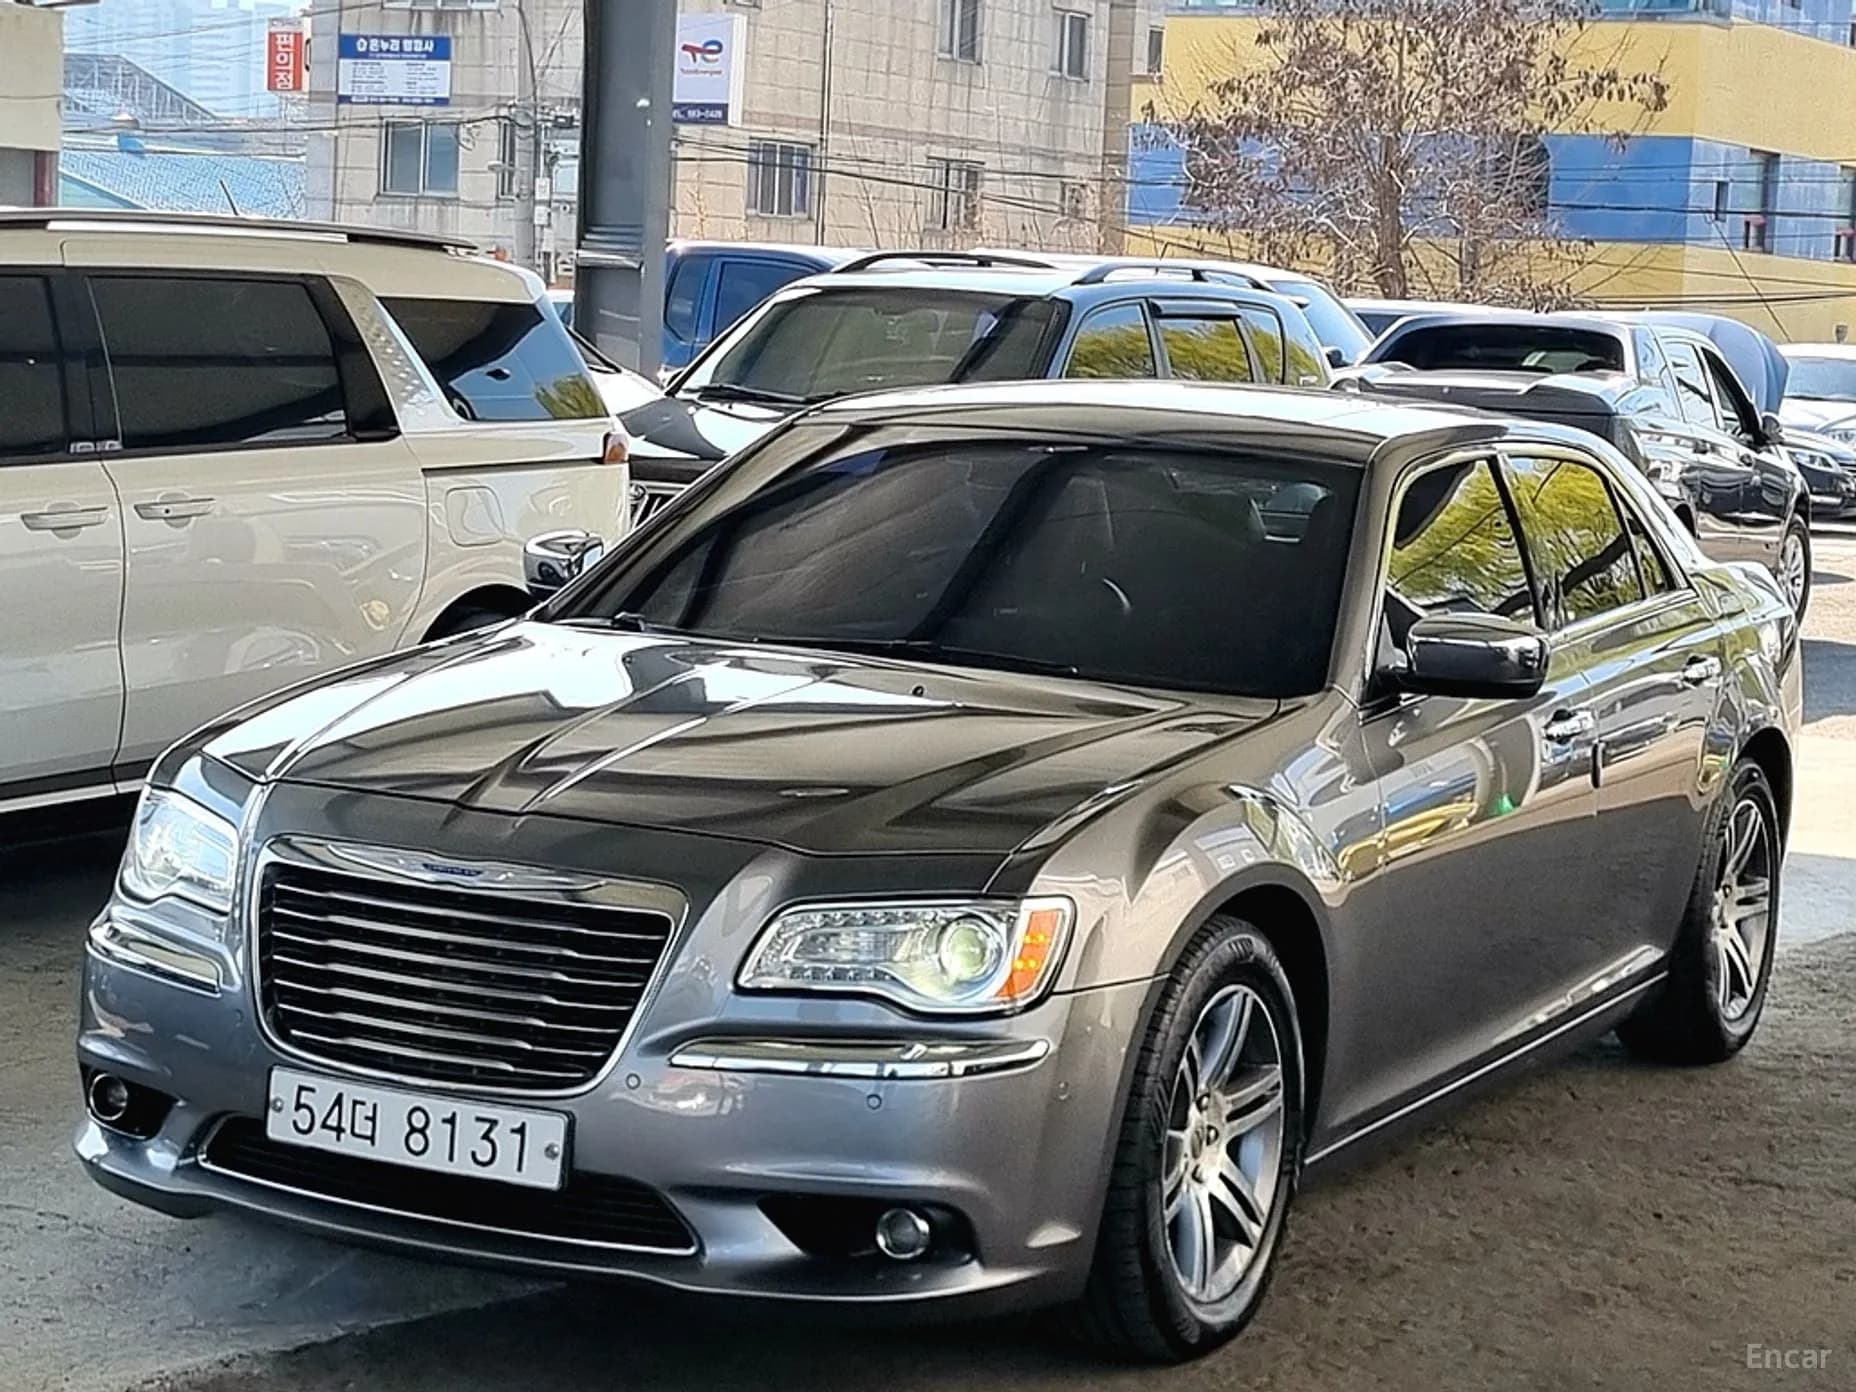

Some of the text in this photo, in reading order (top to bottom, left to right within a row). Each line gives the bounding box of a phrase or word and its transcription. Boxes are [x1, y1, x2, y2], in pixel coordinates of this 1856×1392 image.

[275, 33, 295, 90] 편의점
[292, 1084, 527, 1173] 54더 8131
